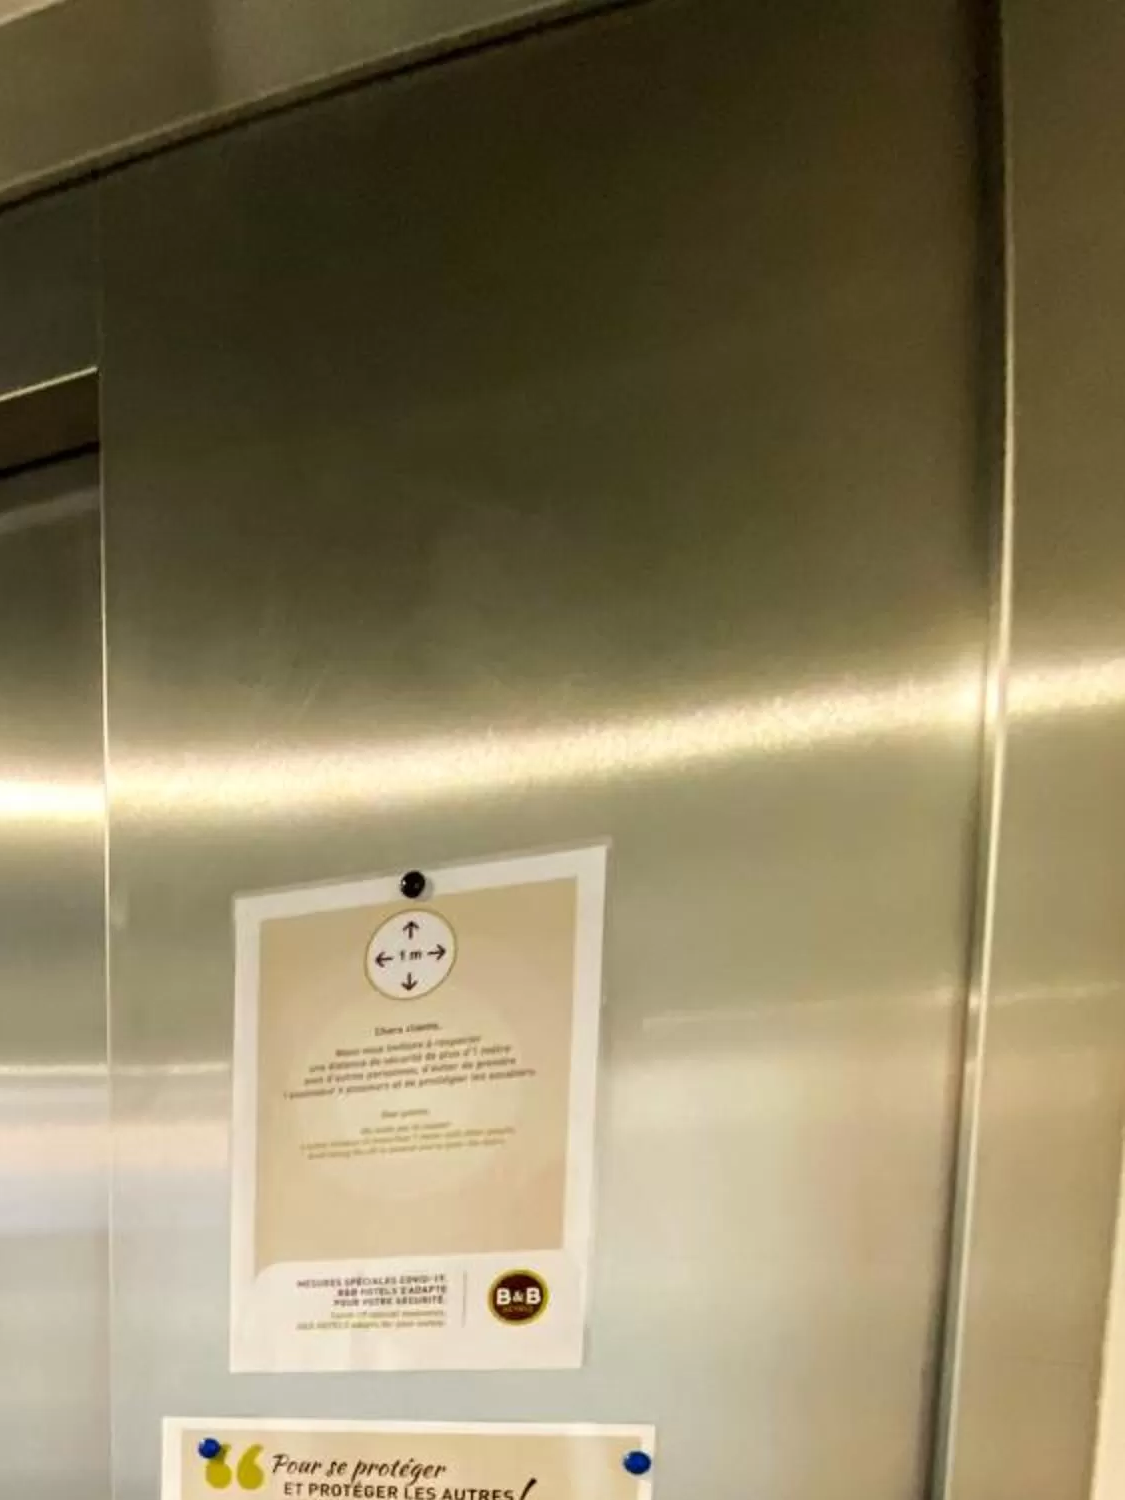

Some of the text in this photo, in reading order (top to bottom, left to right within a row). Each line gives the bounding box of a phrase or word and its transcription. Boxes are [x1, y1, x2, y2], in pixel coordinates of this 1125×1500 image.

[409, 950, 422, 961] m
[272, 1453, 448, 1486] Pour se protéger
[283, 1481, 305, 1496] ET
[308, 1479, 399, 1500] PROTÉGER
